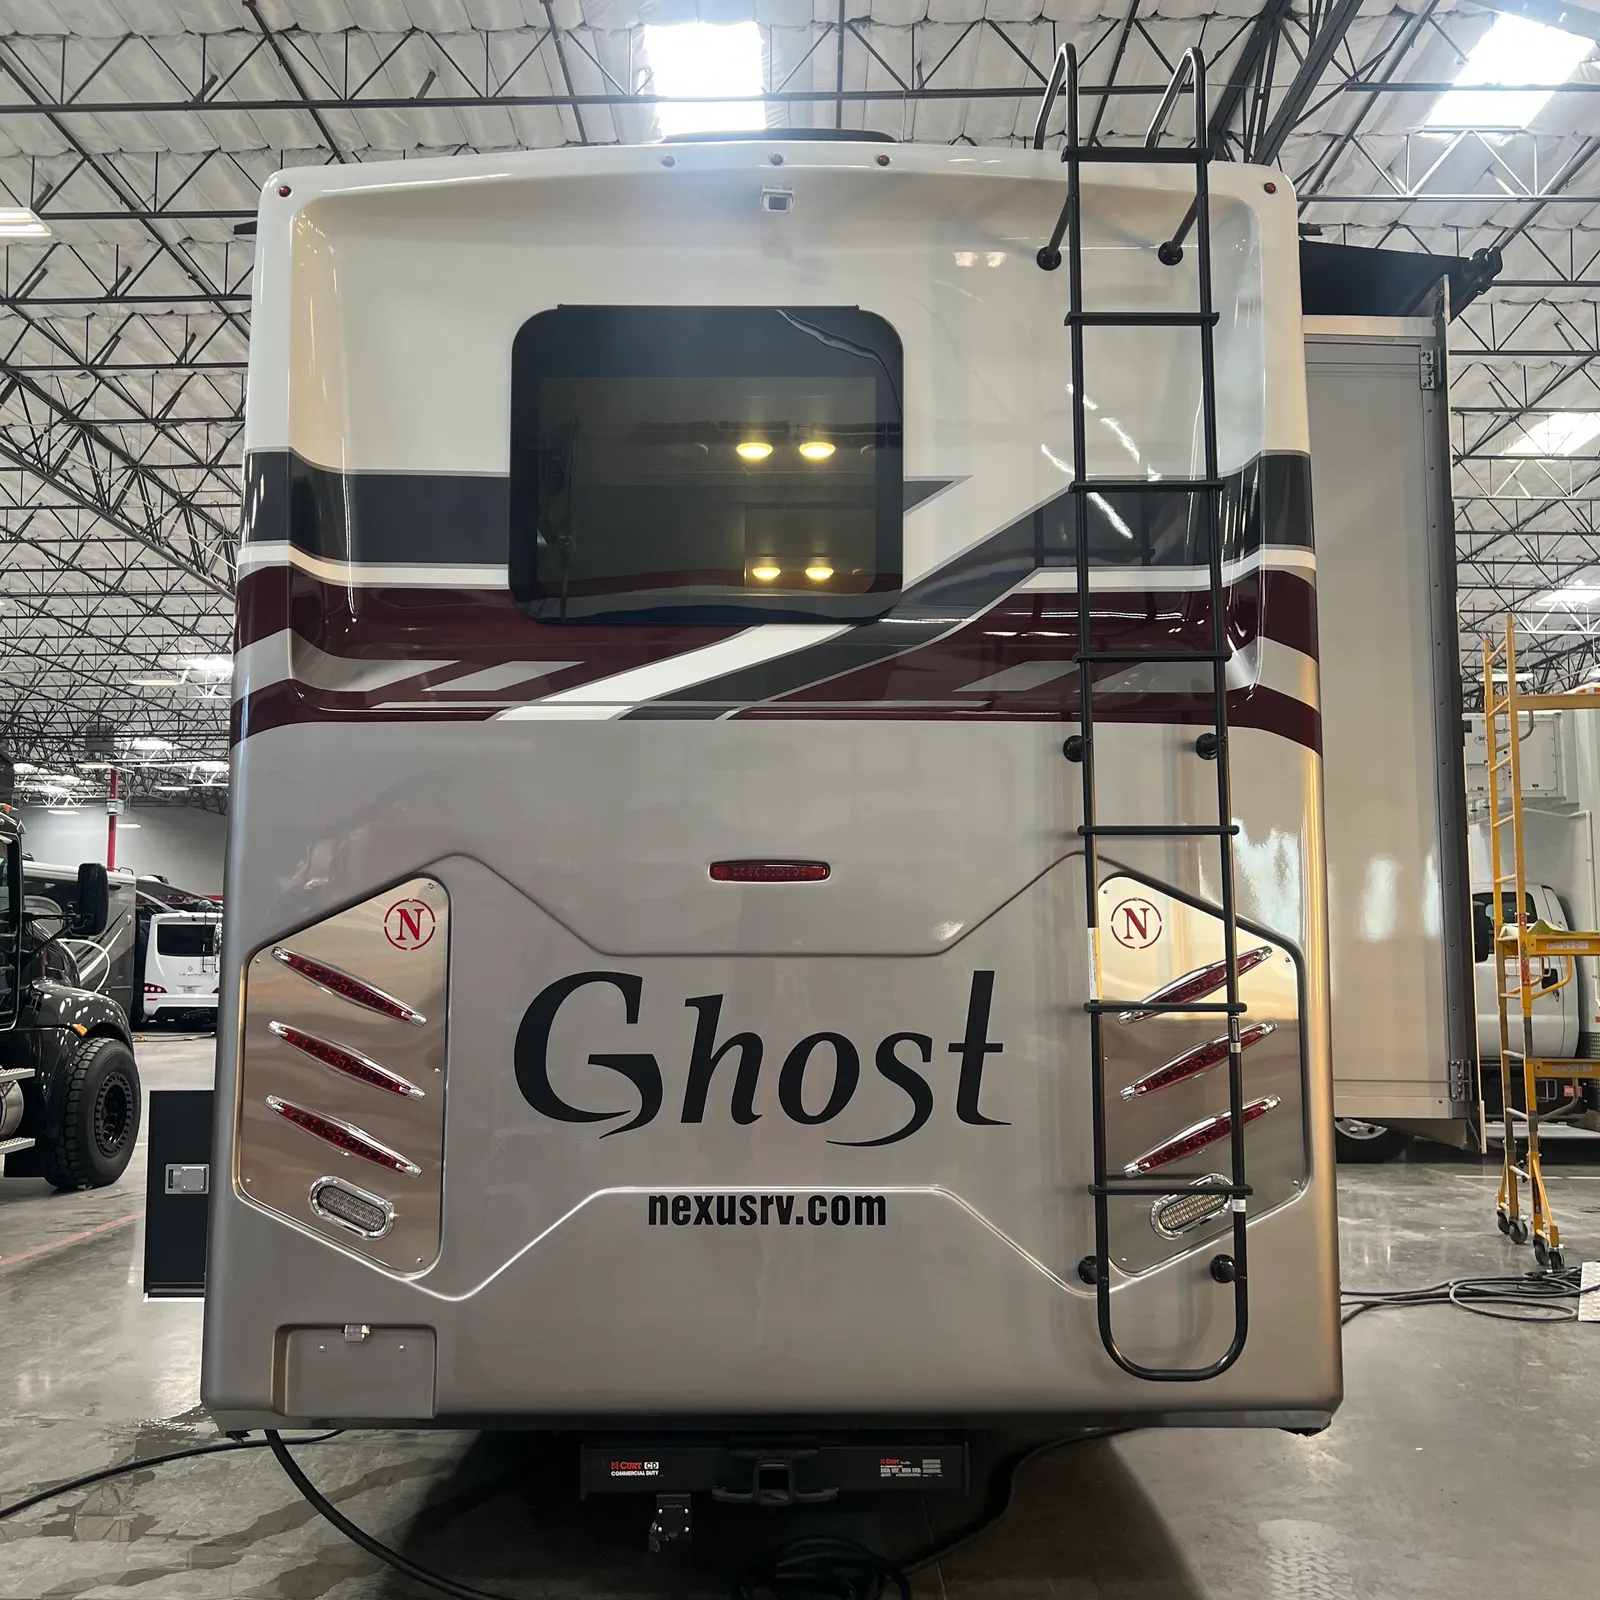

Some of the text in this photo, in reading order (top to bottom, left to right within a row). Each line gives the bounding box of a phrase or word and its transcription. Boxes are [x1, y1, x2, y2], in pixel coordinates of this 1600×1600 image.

[395, 908, 425, 941] N
[1122, 907, 1151, 940] N
[513, 970, 1013, 1148] Ghost
[647, 1193, 887, 1227] nexusrv.com
